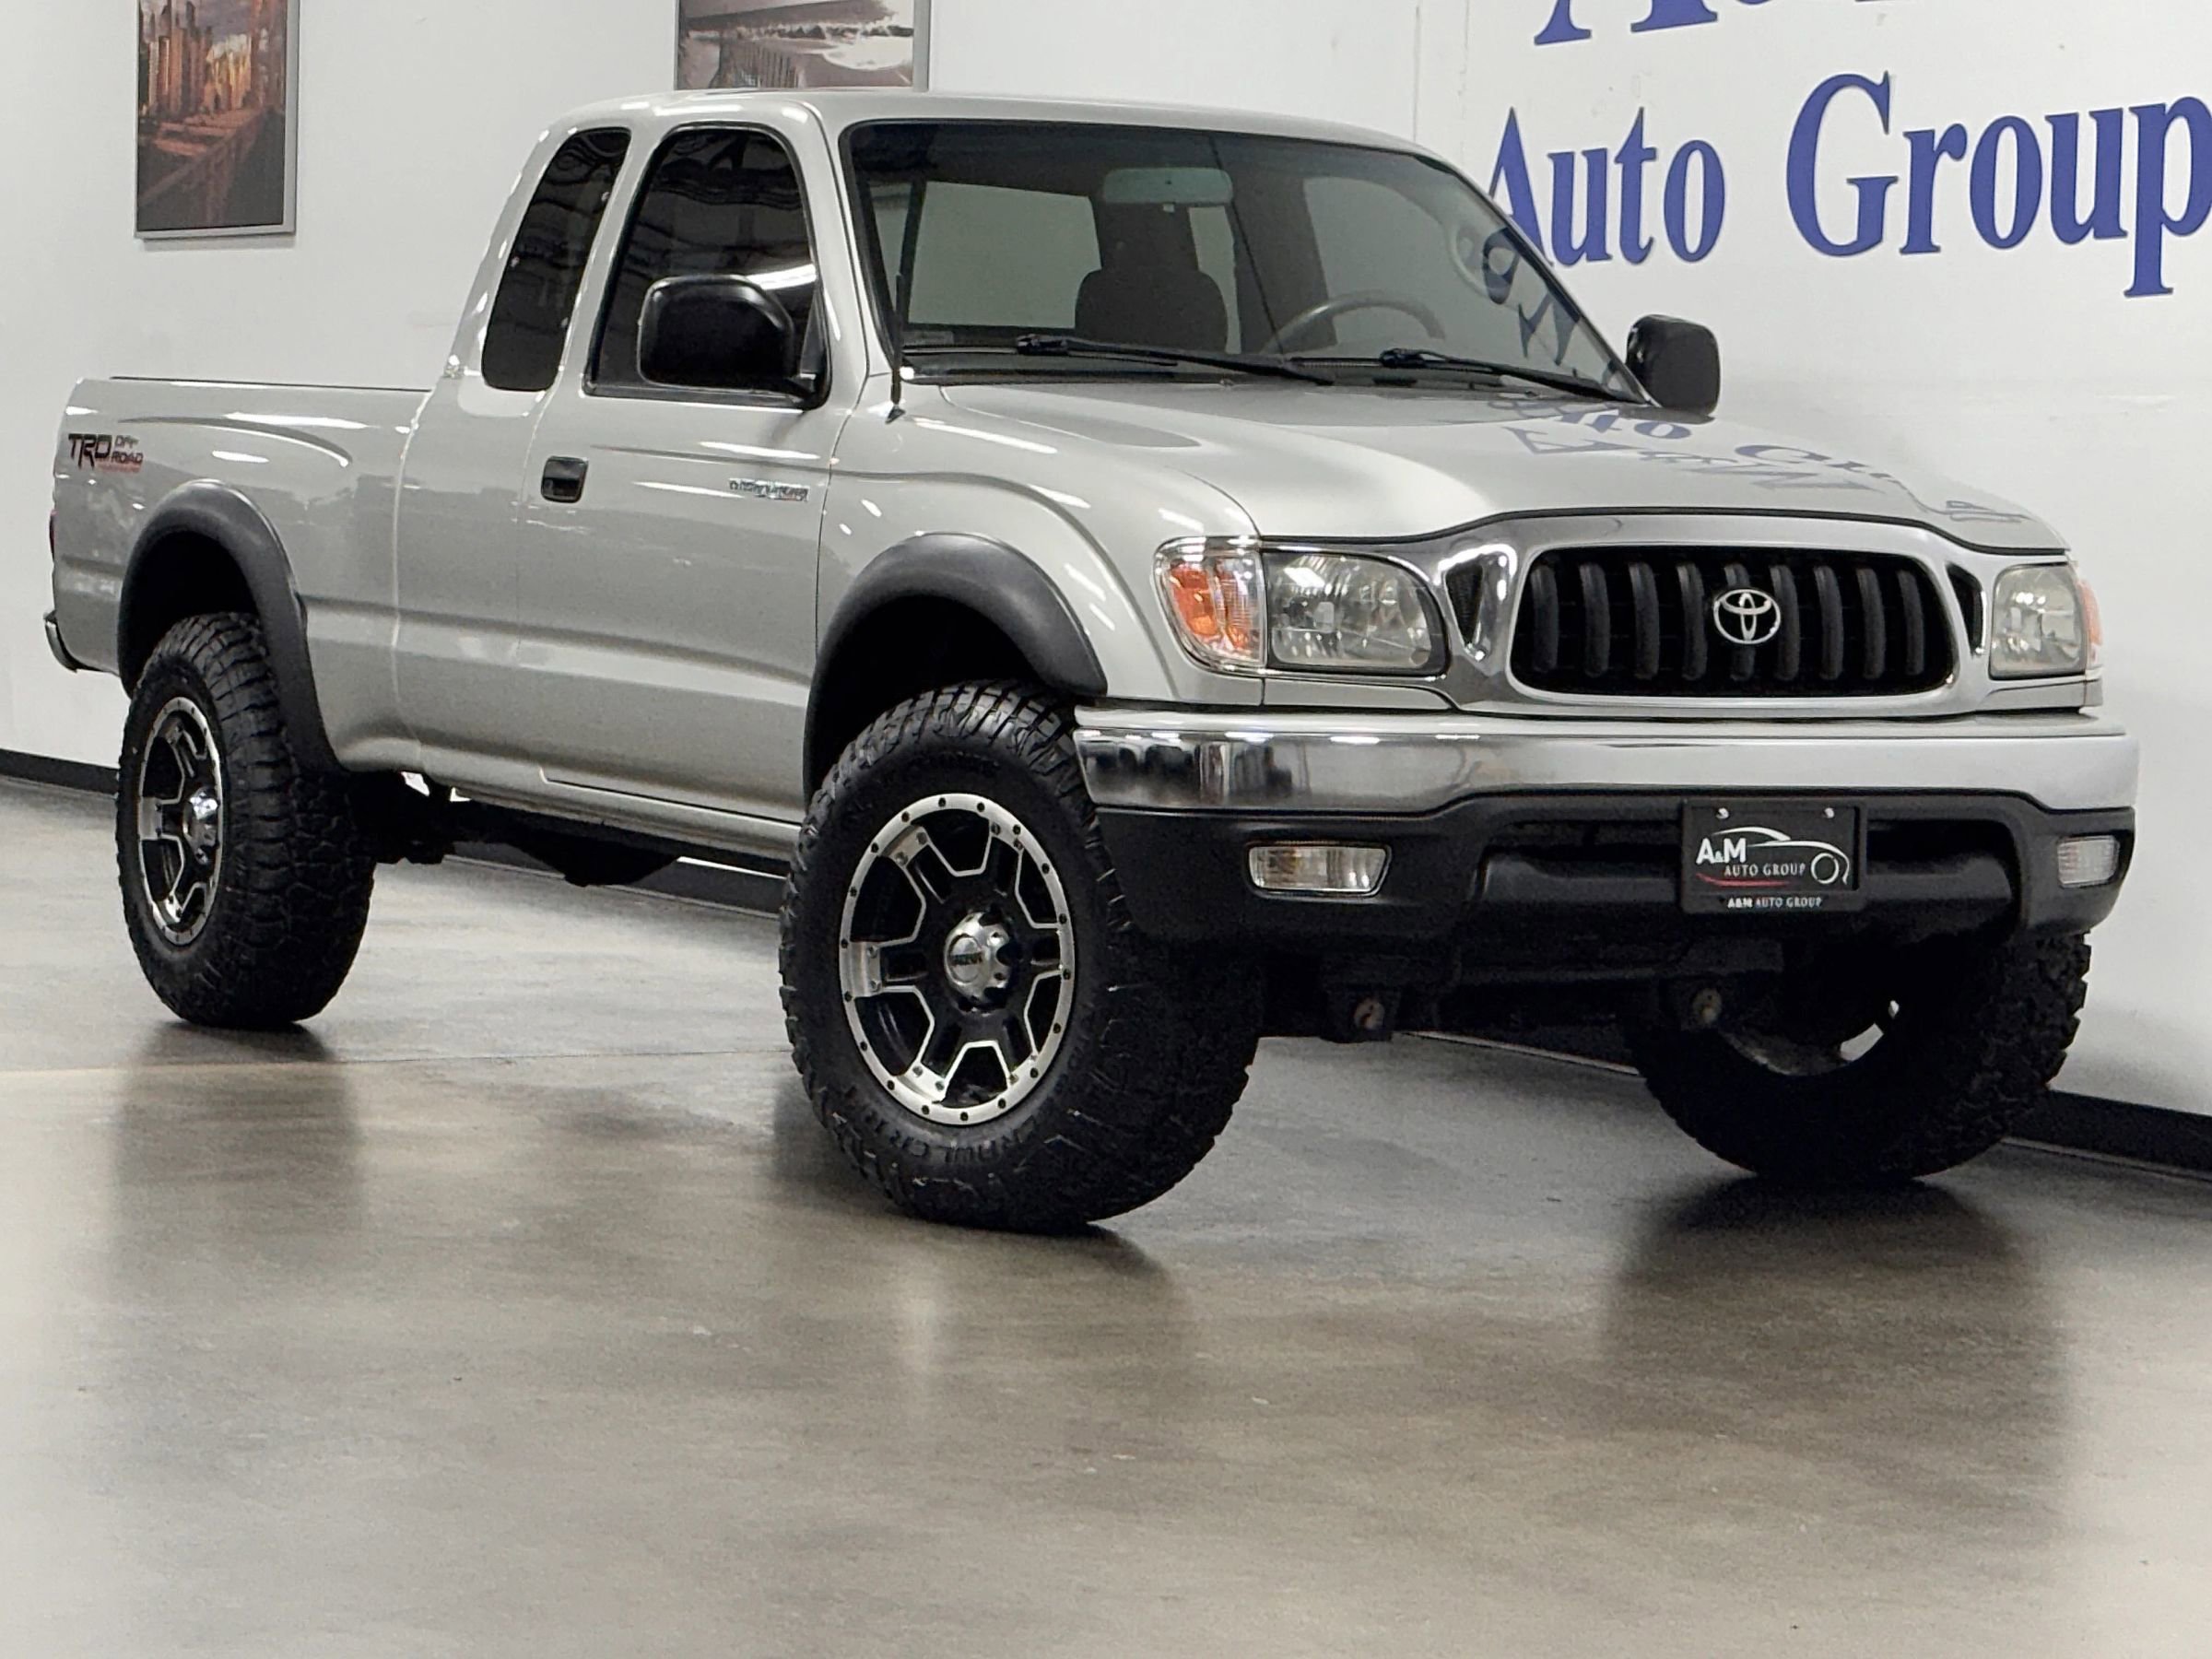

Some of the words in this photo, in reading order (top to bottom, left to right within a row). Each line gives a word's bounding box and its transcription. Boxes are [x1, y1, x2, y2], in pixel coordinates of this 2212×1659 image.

[1488, 106, 1726, 266] Auto
[1786, 69, 2212, 298] Group
[1695, 837, 1747, 865] A&M
[1724, 864, 1759, 877] AUTO
[1762, 863, 1807, 877] GROUP
[1755, 897, 1783, 909] AUTO
[1785, 897, 1823, 909] GROUP
